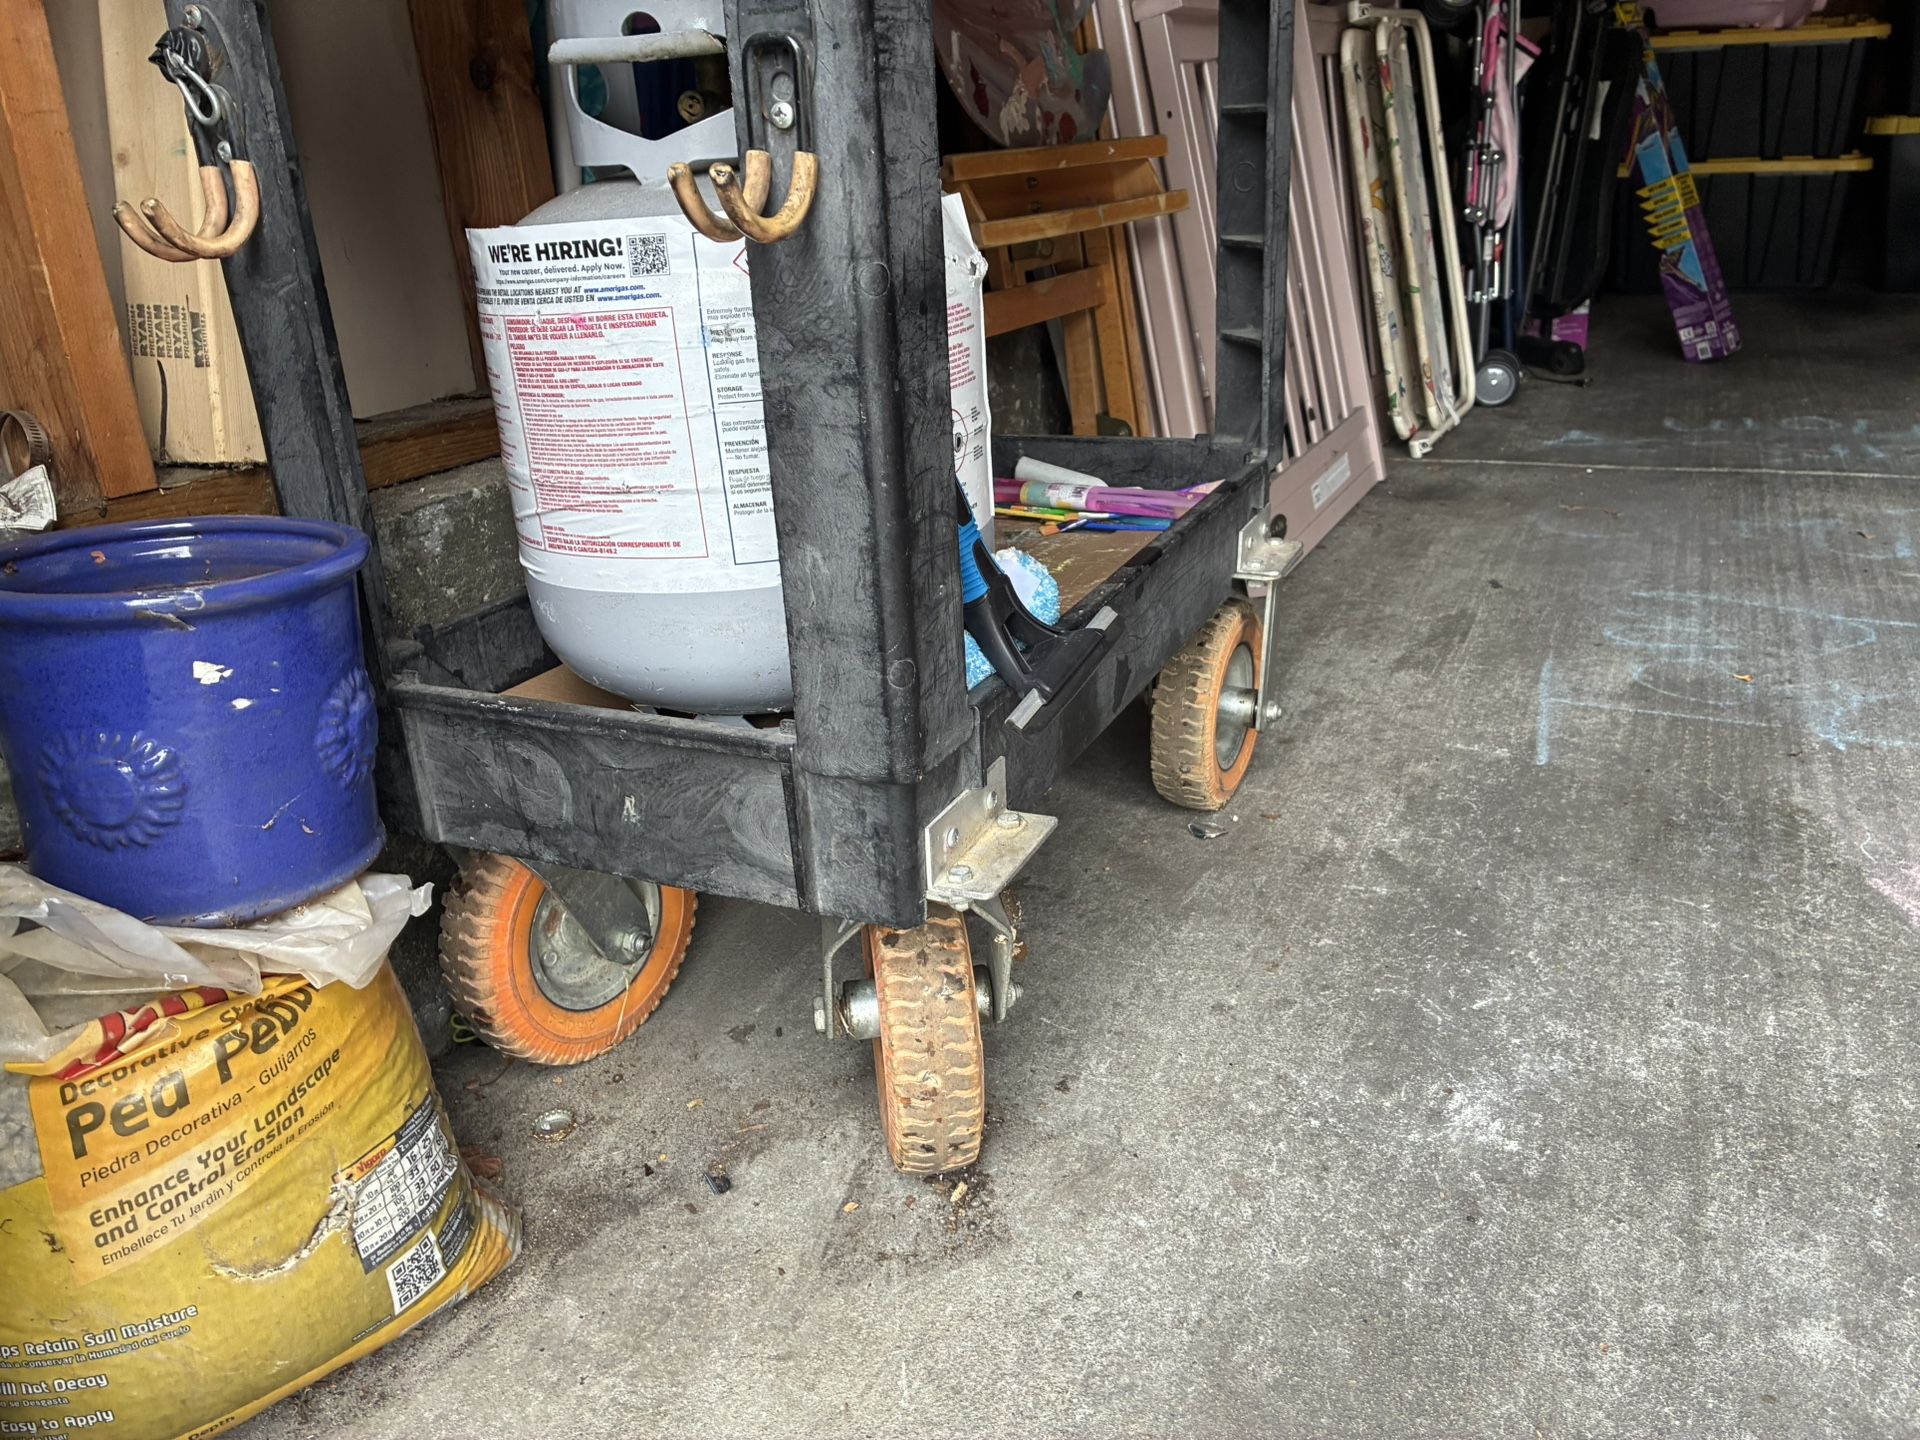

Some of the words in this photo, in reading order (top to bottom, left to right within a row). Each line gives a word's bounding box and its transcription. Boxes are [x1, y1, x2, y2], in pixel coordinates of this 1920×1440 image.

[488, 243, 532, 263] WE'RE
[536, 237, 623, 261] HIRING!
[521, 267, 542, 276] career,
[544, 264, 579, 275] delivered.
[581, 264, 602, 273] Apply
[604, 262, 625, 270] Now.
[535, 287, 558, 295] NEAREST
[584, 284, 646, 293] www.amerigas.com.
[597, 292, 662, 302] www.amerigas.com.
[609, 320, 656, 329] INSPECCIONAR
[635, 311, 668, 319] ETIQUETA.
[59, 1027, 210, 1106] Decorative
[65, 1068, 190, 1160] Pea
[80, 1148, 141, 1188] Piedra
[145, 1092, 243, 1156] Decorativa
[258, 1026, 318, 1086] Guijarros
[88, 1166, 190, 1228] Enhance
[196, 1128, 248, 1170] Your
[252, 1048, 341, 1132] Landscape
[406, 1151, 417, 1165] 16
[422, 1134, 431, 1149] 25
[94, 1215, 139, 1248] and
[145, 1163, 227, 1222] Control
[232, 1105, 306, 1167] Erosion
[101, 1224, 170, 1266] Embellece
[170, 1213, 186, 1226] Tu
[189, 1186, 226, 1218] Jardín
[226, 1179, 234, 1192] y
[285, 1134, 295, 1144] la
[297, 1100, 336, 1136] Erosión
[409, 1164, 419, 1180] 33
[357, 1231, 365, 1240] 10
[375, 1218, 382, 1227] 10
[393, 1194, 406, 1206] 100
[414, 1177, 426, 1193] 33
[430, 1160, 440, 1176] 50
[362, 1245, 370, 1254] 10
[379, 1232, 387, 1242] 20
[418, 1190, 430, 1206] 66
[24, 1338, 80, 1356] Retain
[83, 1328, 117, 1347] Soil
[120, 1304, 199, 1339] Moisture
[22, 1356, 74, 1368] Conservar
[76, 1354, 86, 1363] la
[88, 1342, 140, 1360] Humedad
[141, 1336, 158, 1348] del
[161, 1325, 191, 1341] Suelo
[20, 1381, 51, 1395] Not
[53, 1373, 109, 1393] Decay
[22, 1396, 70, 1408] Desgasta
[0, 1420, 37, 1434] Easy
[41, 1418, 59, 1430] to
[64, 1409, 115, 1429] Apply
